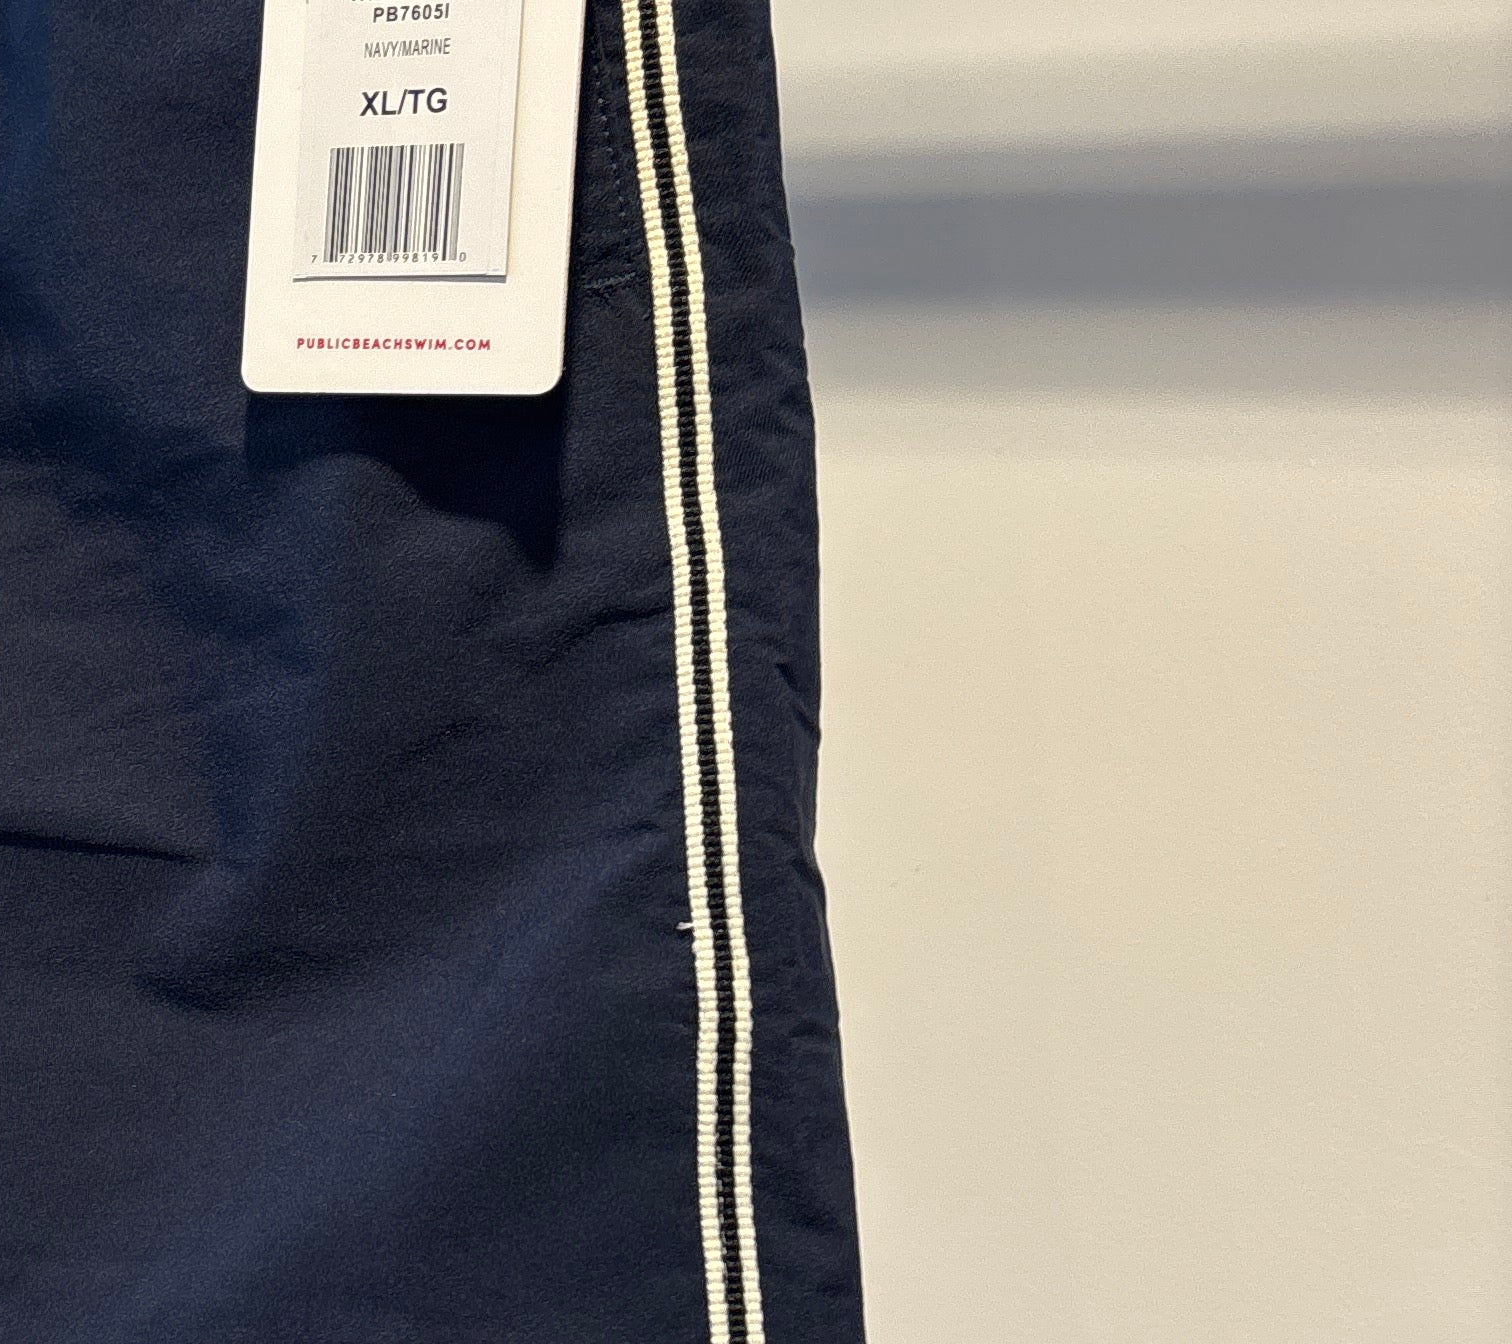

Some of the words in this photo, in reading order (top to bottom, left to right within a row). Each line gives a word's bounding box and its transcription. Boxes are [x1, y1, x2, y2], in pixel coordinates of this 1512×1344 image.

[363, 37, 451, 58] NAVY/MARINE
[359, 87, 448, 117] XL/TG
[296, 337, 491, 351] PUBLICBEACHSWIM.COM
